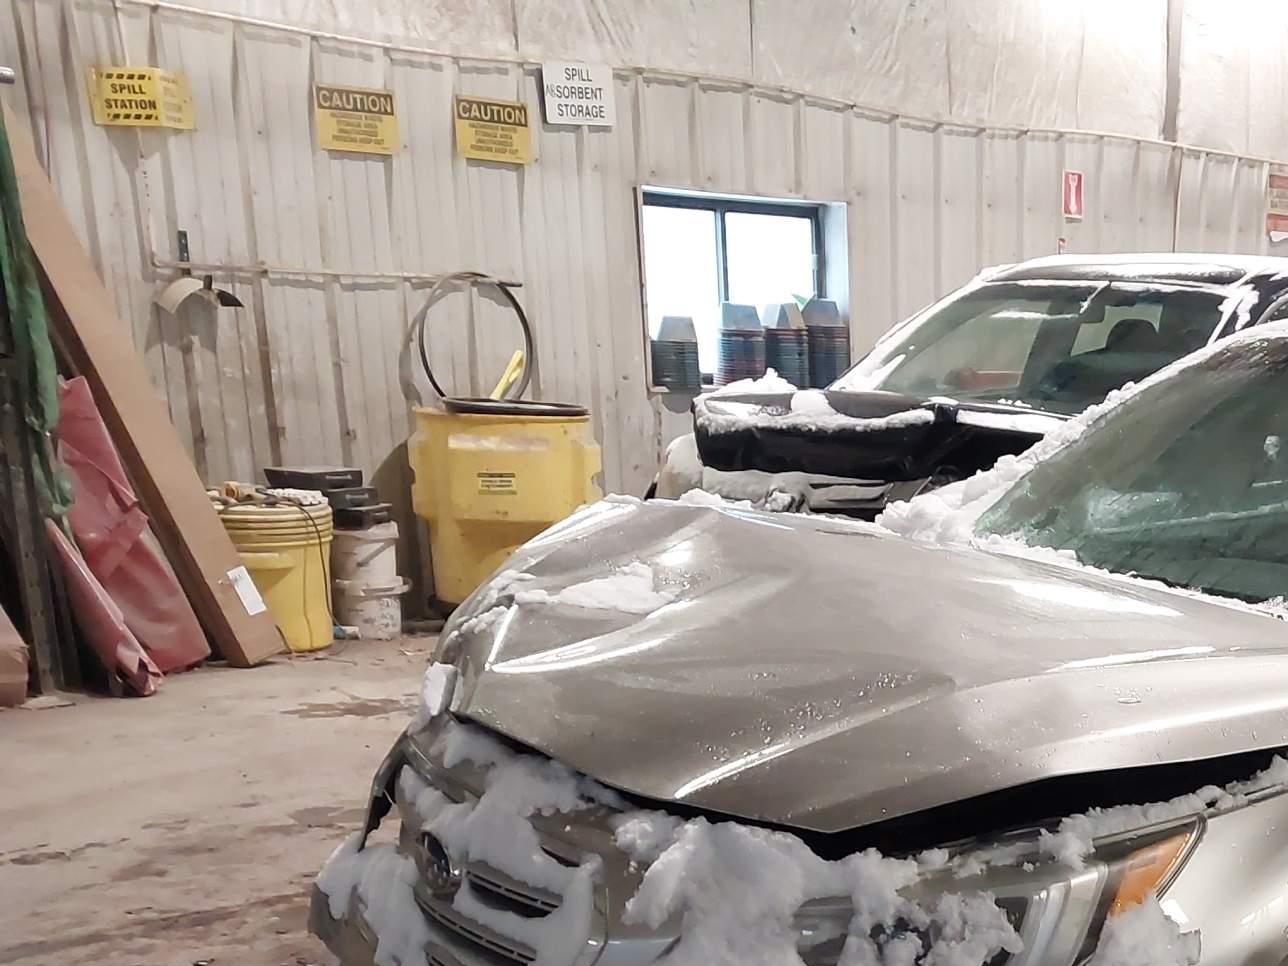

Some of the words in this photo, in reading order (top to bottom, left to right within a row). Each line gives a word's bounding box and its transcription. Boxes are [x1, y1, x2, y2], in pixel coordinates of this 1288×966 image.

[564, 67, 593, 82] SPILL
[110, 83, 147, 95] SPILL
[104, 98, 157, 110] STATION
[319, 90, 392, 113] CAUTION
[459, 102, 525, 125] CAUTION
[557, 103, 605, 119] STORAGE
